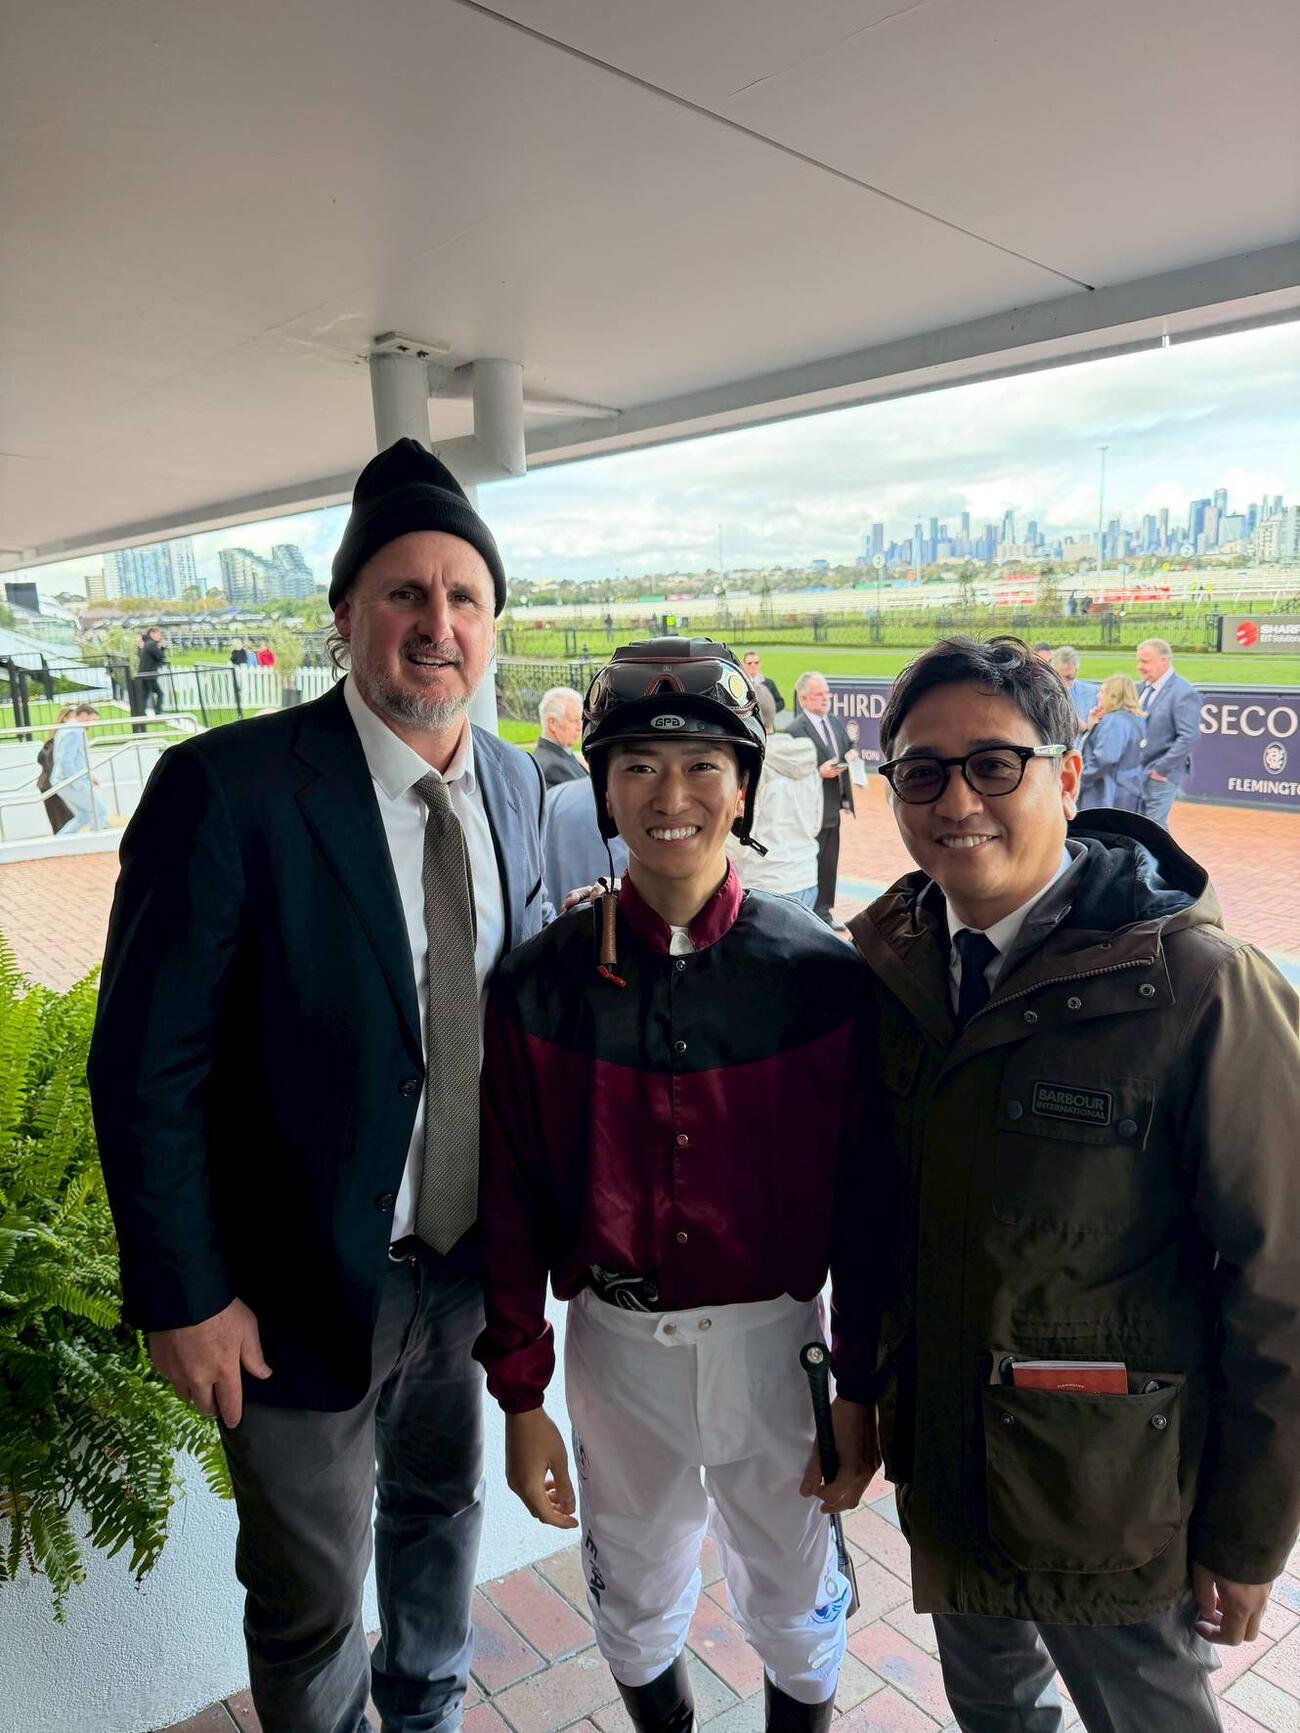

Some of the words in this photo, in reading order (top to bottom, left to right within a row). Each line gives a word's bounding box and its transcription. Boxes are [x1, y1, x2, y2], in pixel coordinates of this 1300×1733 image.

[1199, 704, 1298, 738] SECO
[1036, 1101, 1106, 1120] INTERNATIONAL
[1039, 1088, 1105, 1111] BARBOUR
